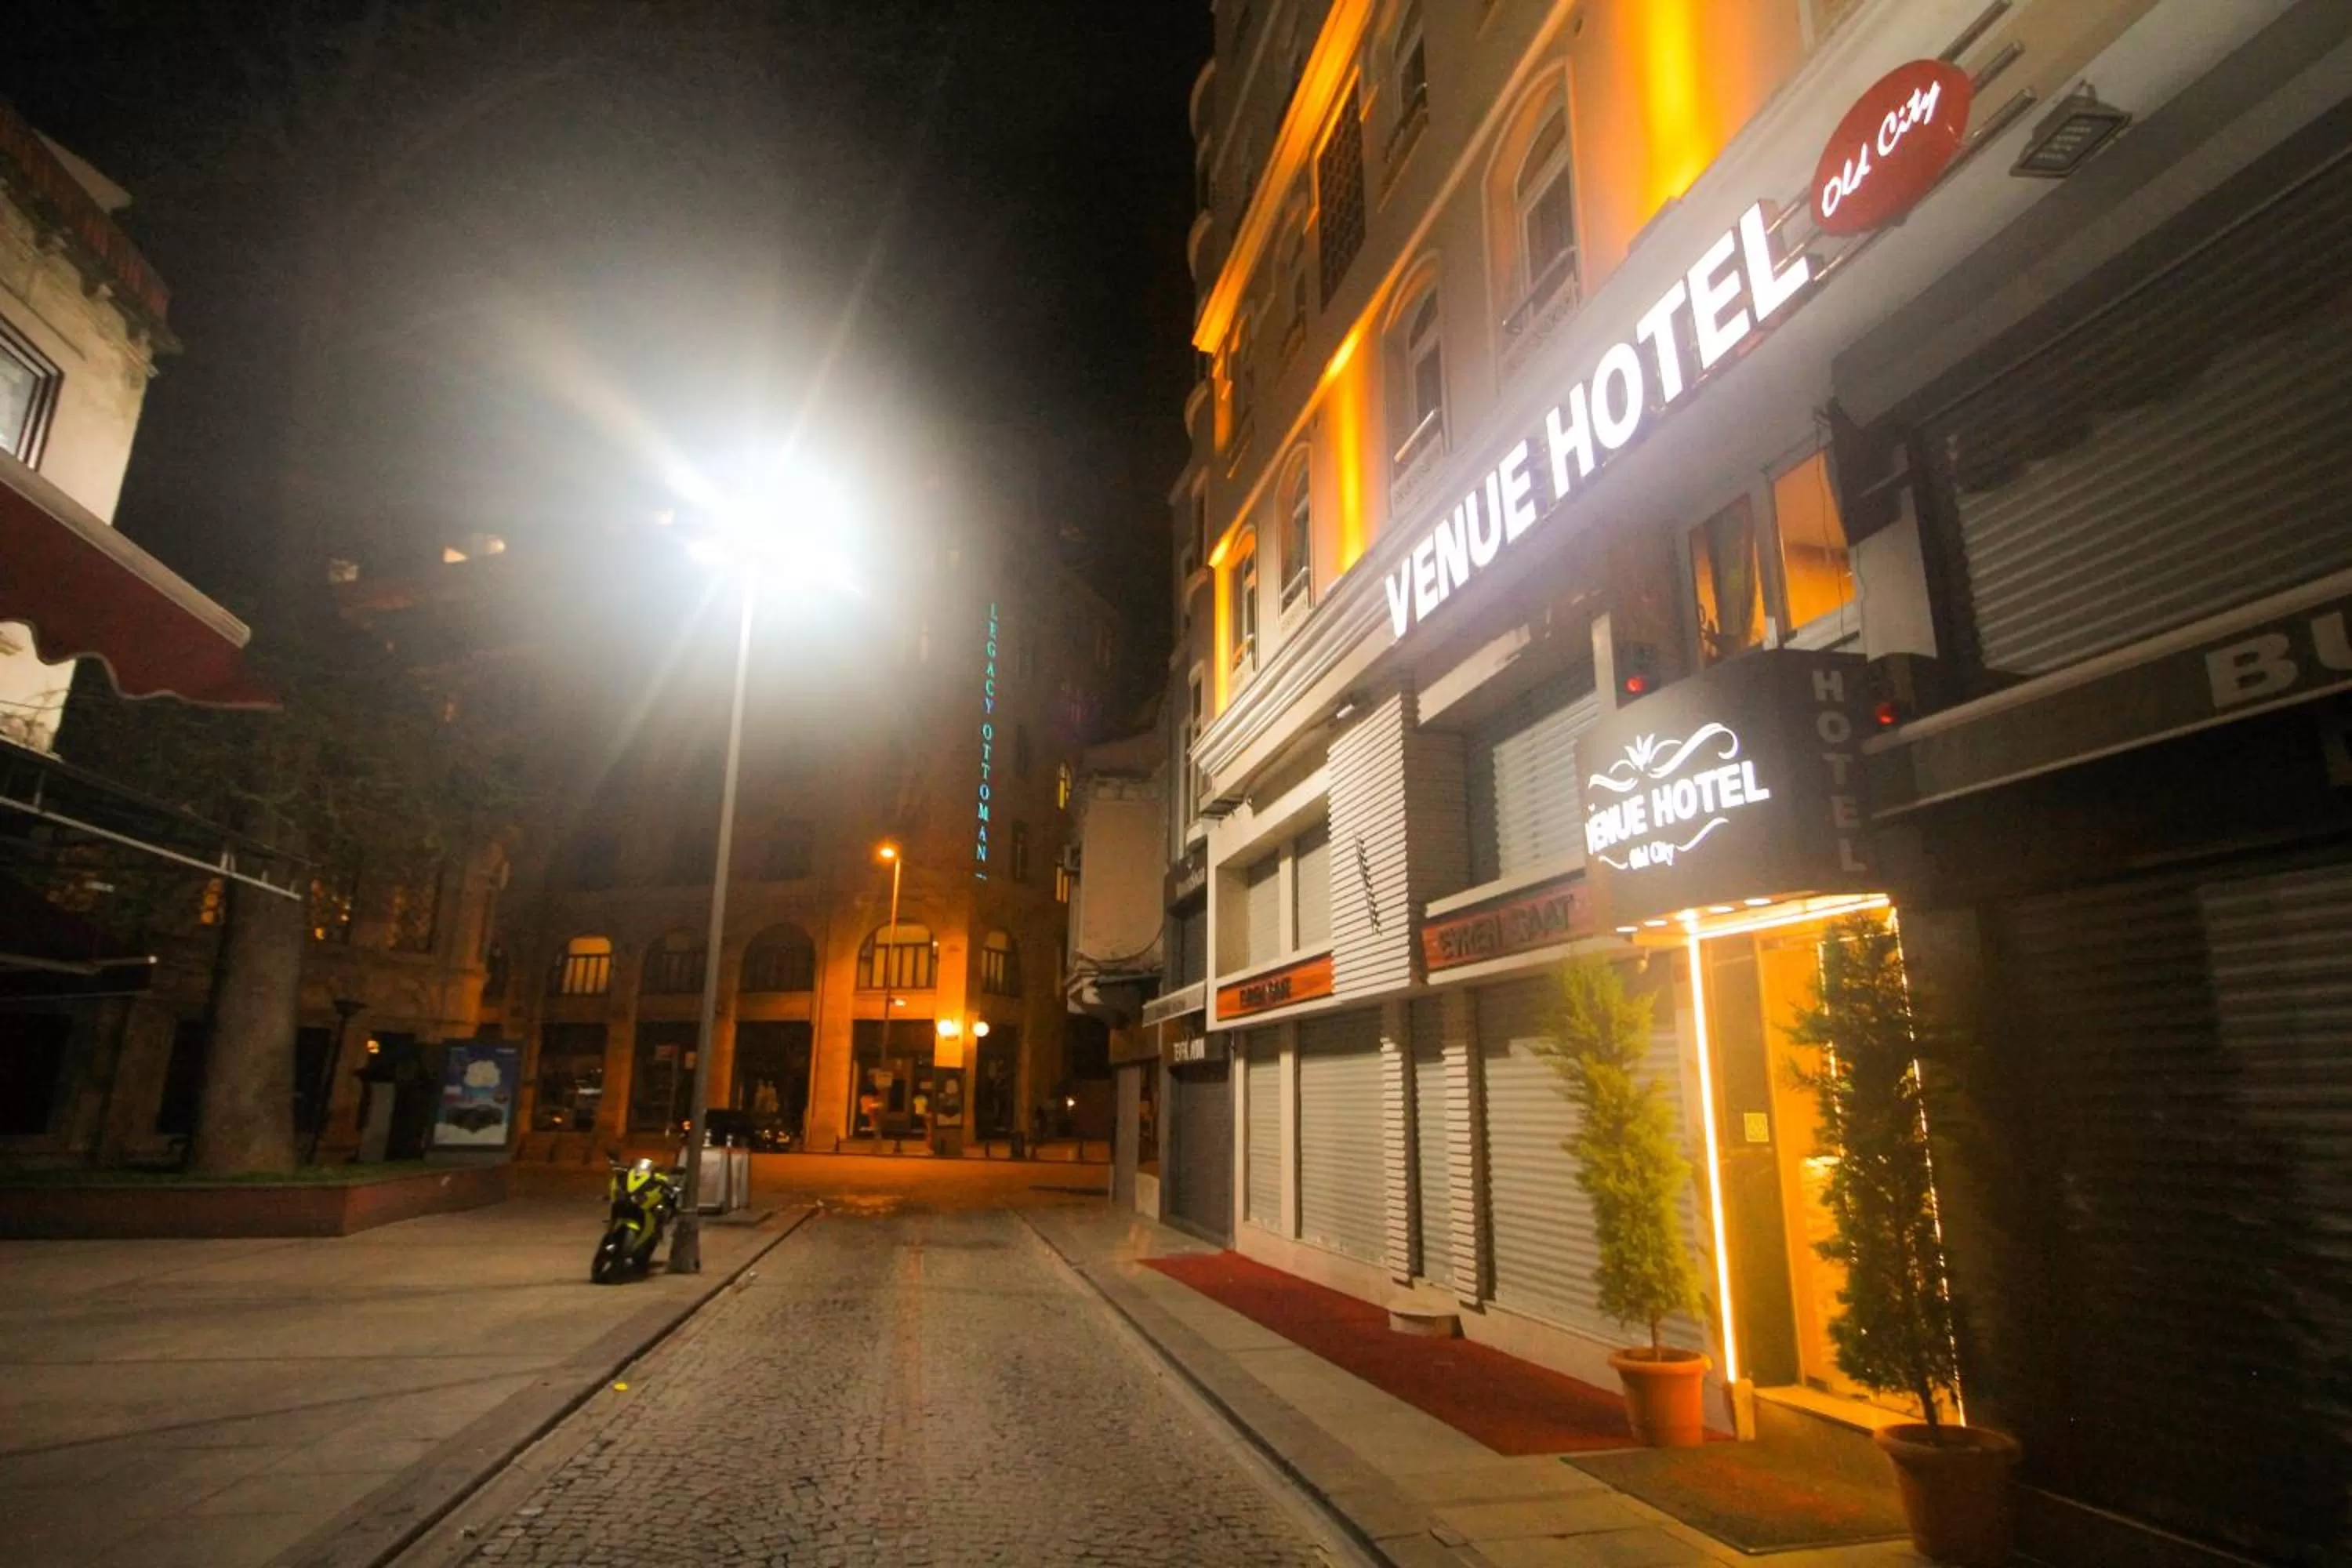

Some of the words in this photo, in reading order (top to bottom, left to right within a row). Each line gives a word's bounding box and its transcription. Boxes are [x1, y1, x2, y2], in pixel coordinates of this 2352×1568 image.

[1821, 142, 1871, 218] Old
[1877, 81, 1942, 157] City
[1385, 438, 1537, 640] VENUE
[1545, 201, 1809, 500] HOTEL
[985, 602, 998, 715] LEGACY
[977, 723, 993, 862] OTTOMAN
[1651, 760, 1771, 828] HOTEL
[1812, 670, 1867, 872] HOTEL
